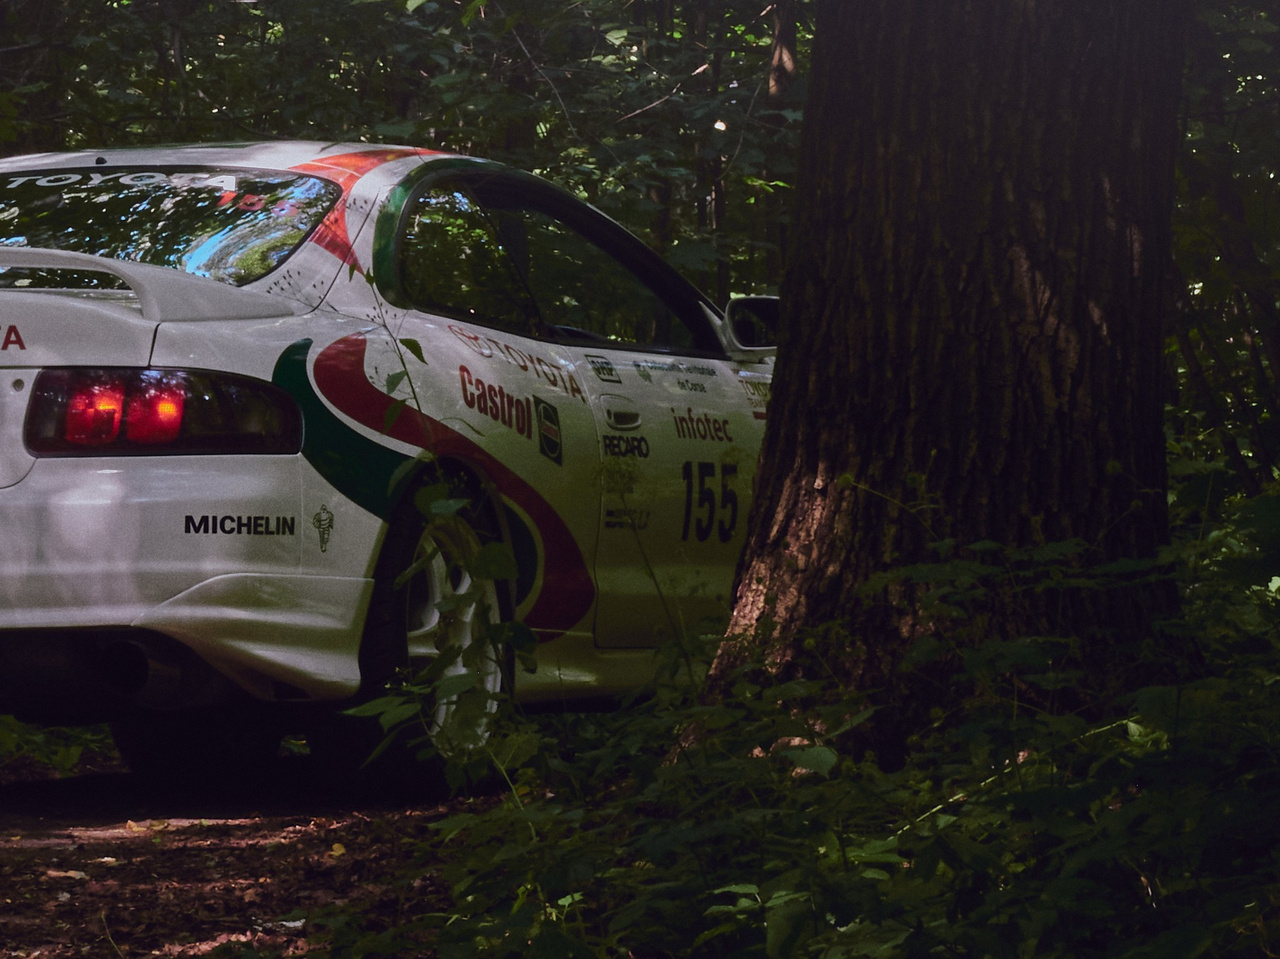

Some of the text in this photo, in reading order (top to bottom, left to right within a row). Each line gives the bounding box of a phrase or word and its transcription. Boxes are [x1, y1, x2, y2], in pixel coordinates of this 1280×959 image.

[6, 172, 237, 192] TOYOTA
[486, 338, 586, 404] TOYOTA
[459, 365, 532, 440] Castrol
[671, 407, 733, 442] infotec
[602, 435, 650, 458] RECARO
[681, 461, 738, 543] 155
[184, 515, 295, 536] MICHELIN
